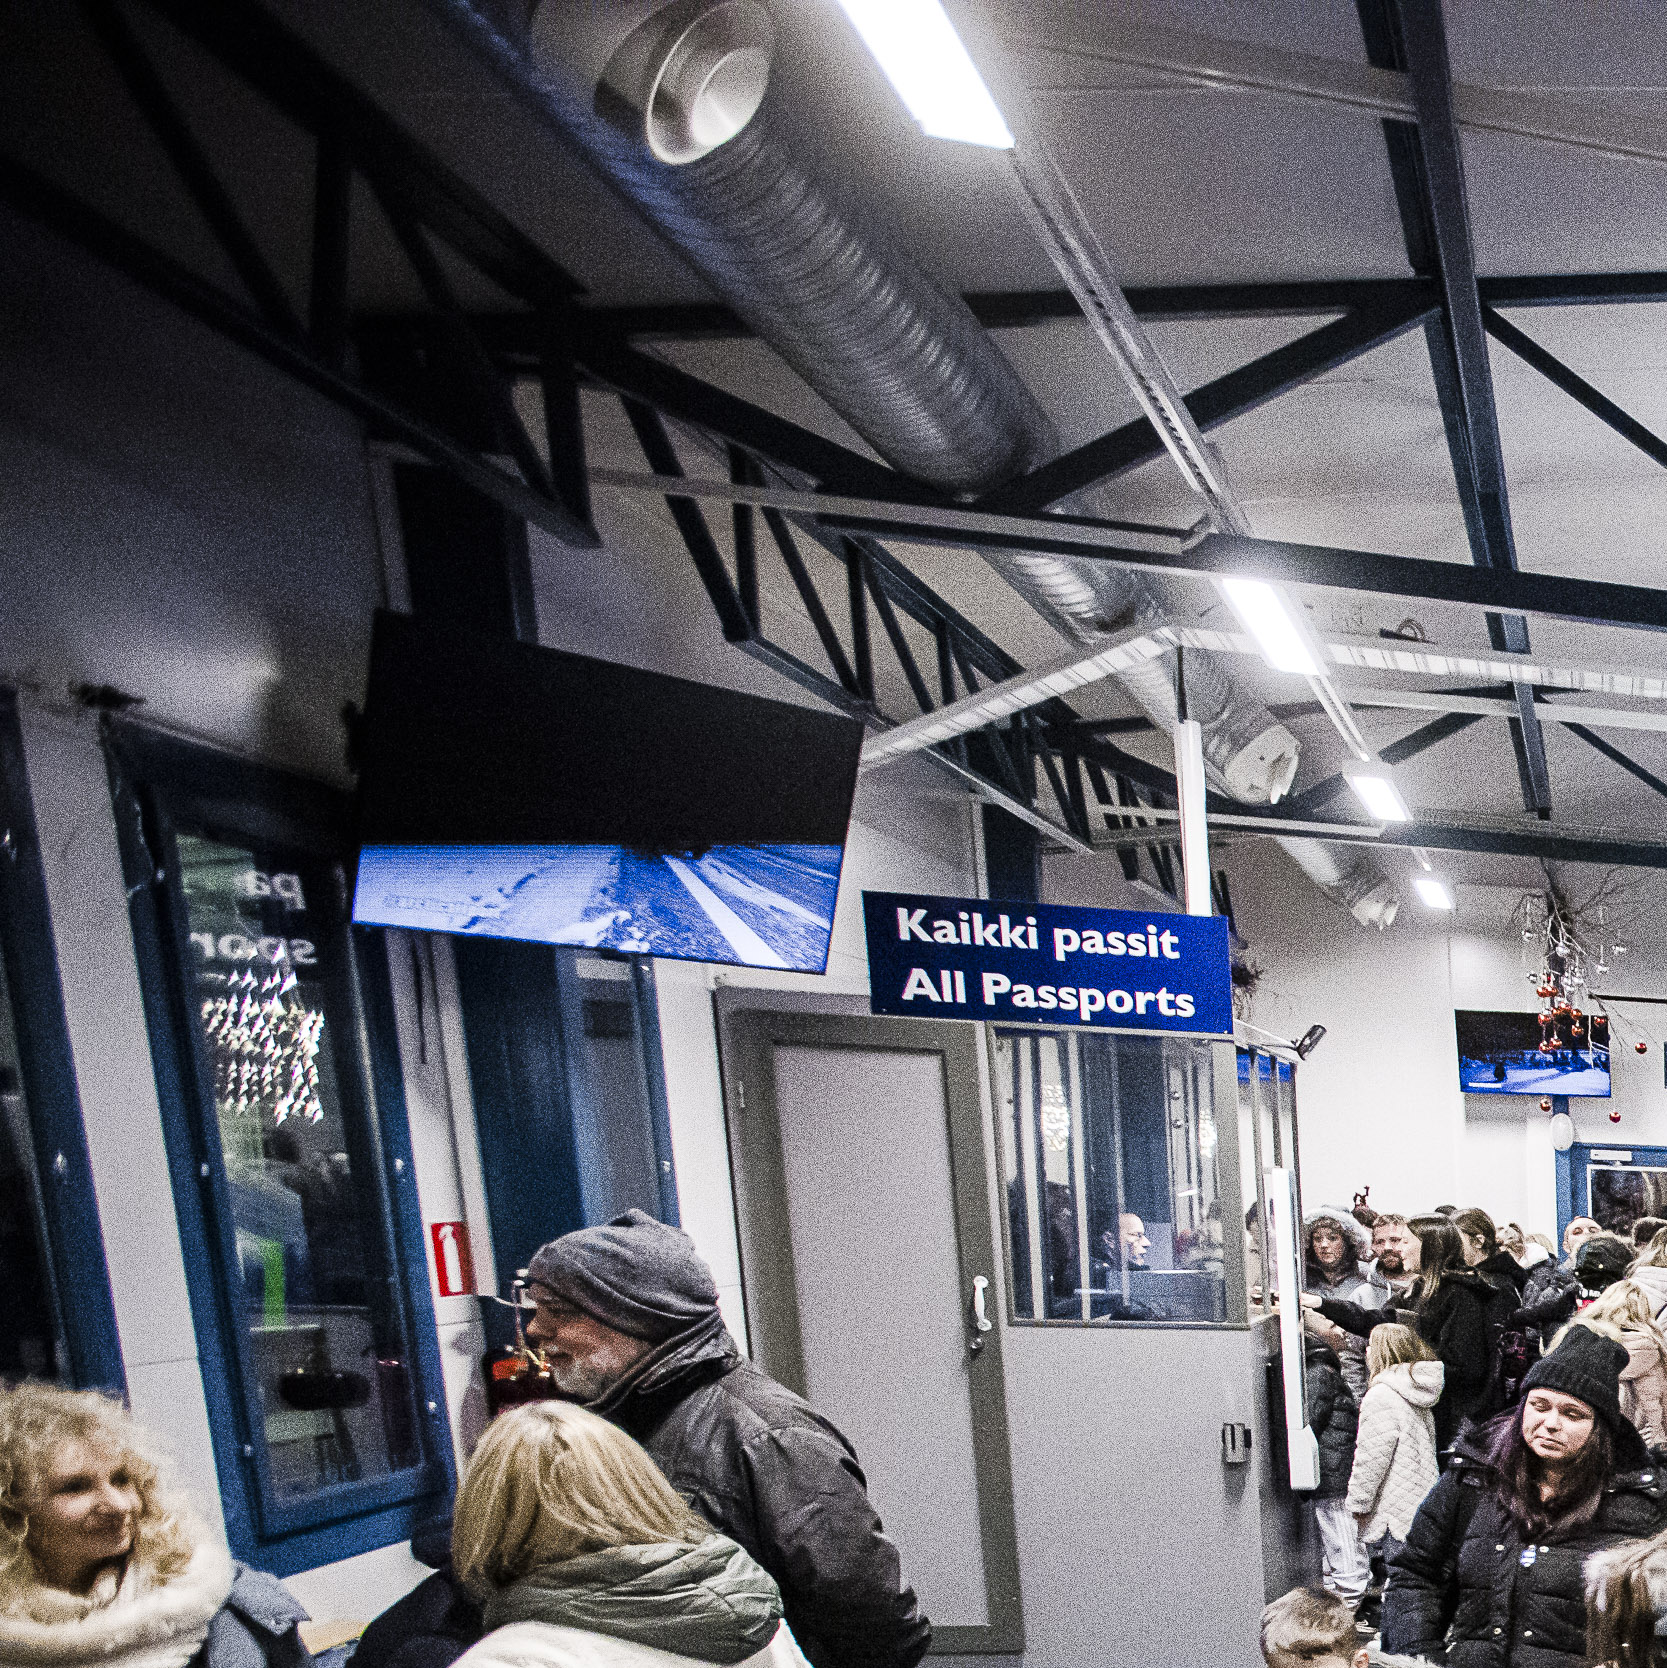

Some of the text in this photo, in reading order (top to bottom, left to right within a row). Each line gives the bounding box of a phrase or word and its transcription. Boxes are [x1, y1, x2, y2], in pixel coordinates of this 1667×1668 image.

[896, 907, 1181, 962] Kaikki passit
[901, 967, 1196, 1021] All Passports
